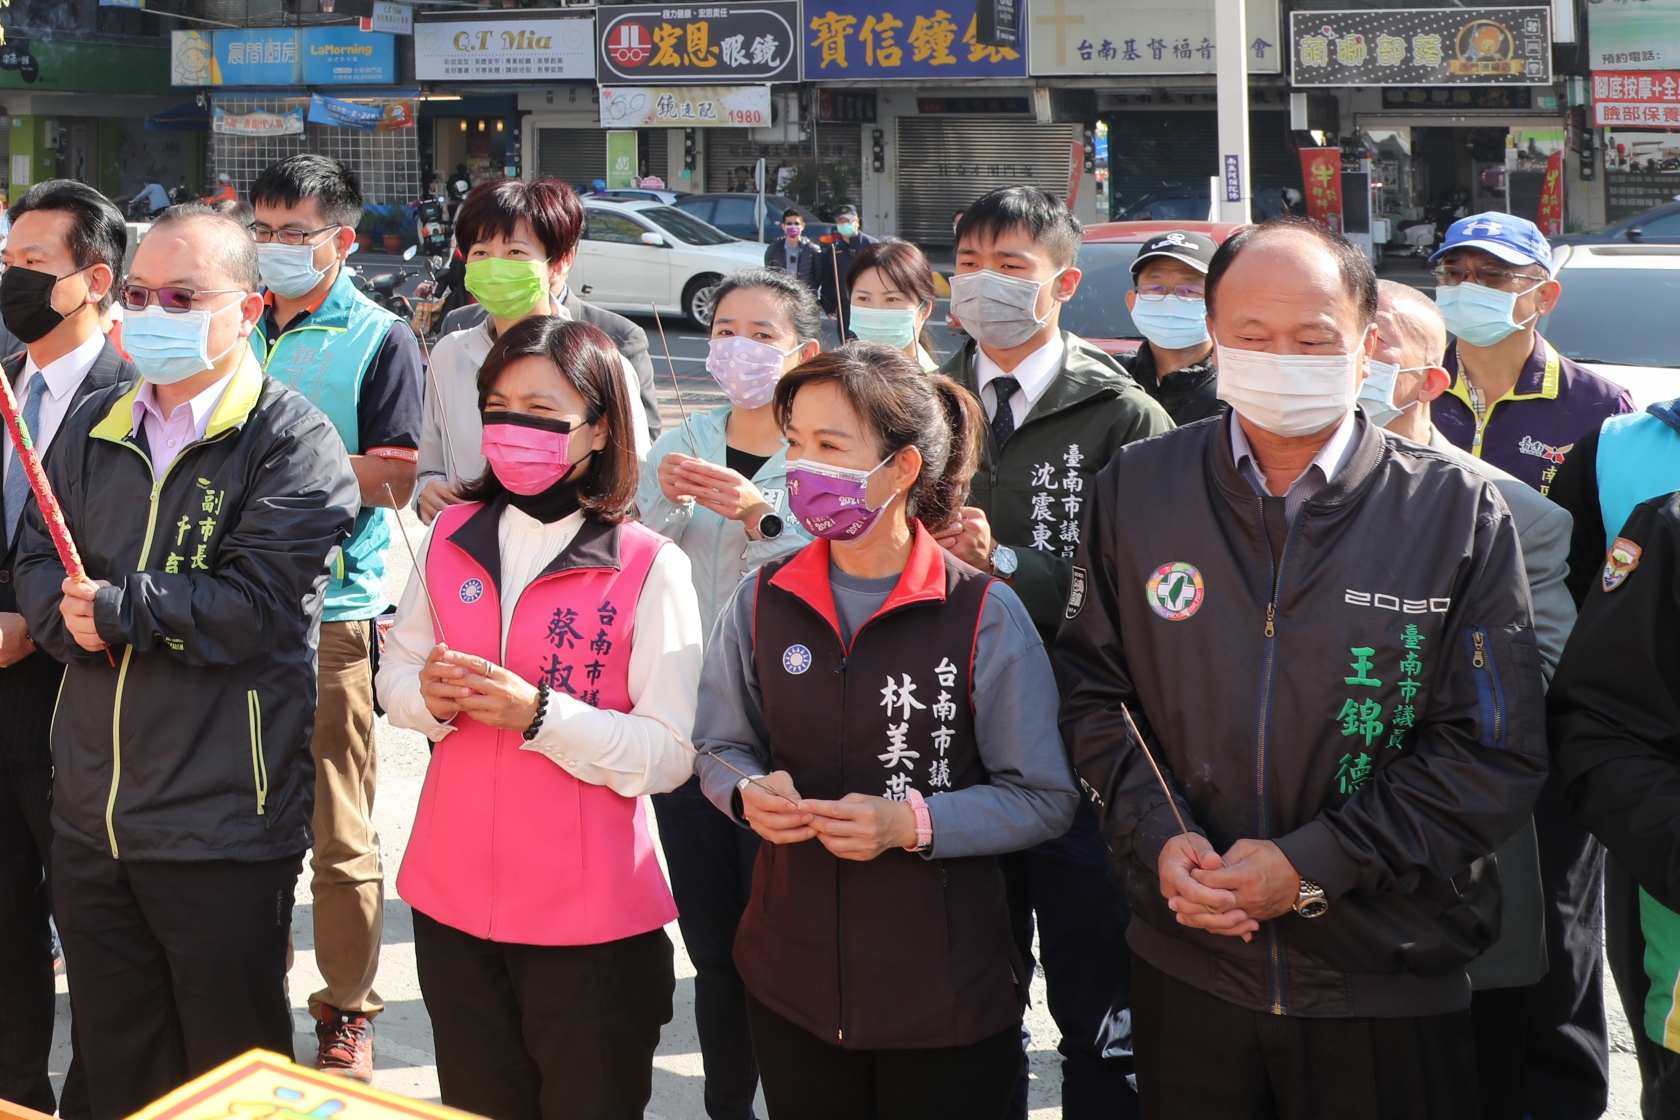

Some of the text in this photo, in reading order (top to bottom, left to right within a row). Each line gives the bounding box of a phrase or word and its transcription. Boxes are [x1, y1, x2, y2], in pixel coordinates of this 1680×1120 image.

[227, 41, 299, 64] 晨間廚房
[310, 43, 372, 57] LaMorning
[453, 30, 552, 52] Q.T Mia
[648, 20, 781, 68] 宏恩眼鏡
[1077, 37, 1273, 62] 台南基督福音會
[1602, 50, 1661, 65] 預約電話:
[1594, 76, 1680, 100] 腳底按摩+全
[656, 94, 717, 120] 鏡速配
[728, 109, 761, 125] 1980
[1029, 461, 1058, 551] 沈震東
[190, 489, 224, 570] 副市長
[815, 519, 836, 532] 2021
[846, 520, 865, 535] 2021
[1345, 589, 1451, 614] 2020
[1385, 623, 1426, 750] 臺南市議員
[928, 657, 958, 796] 台南市議
